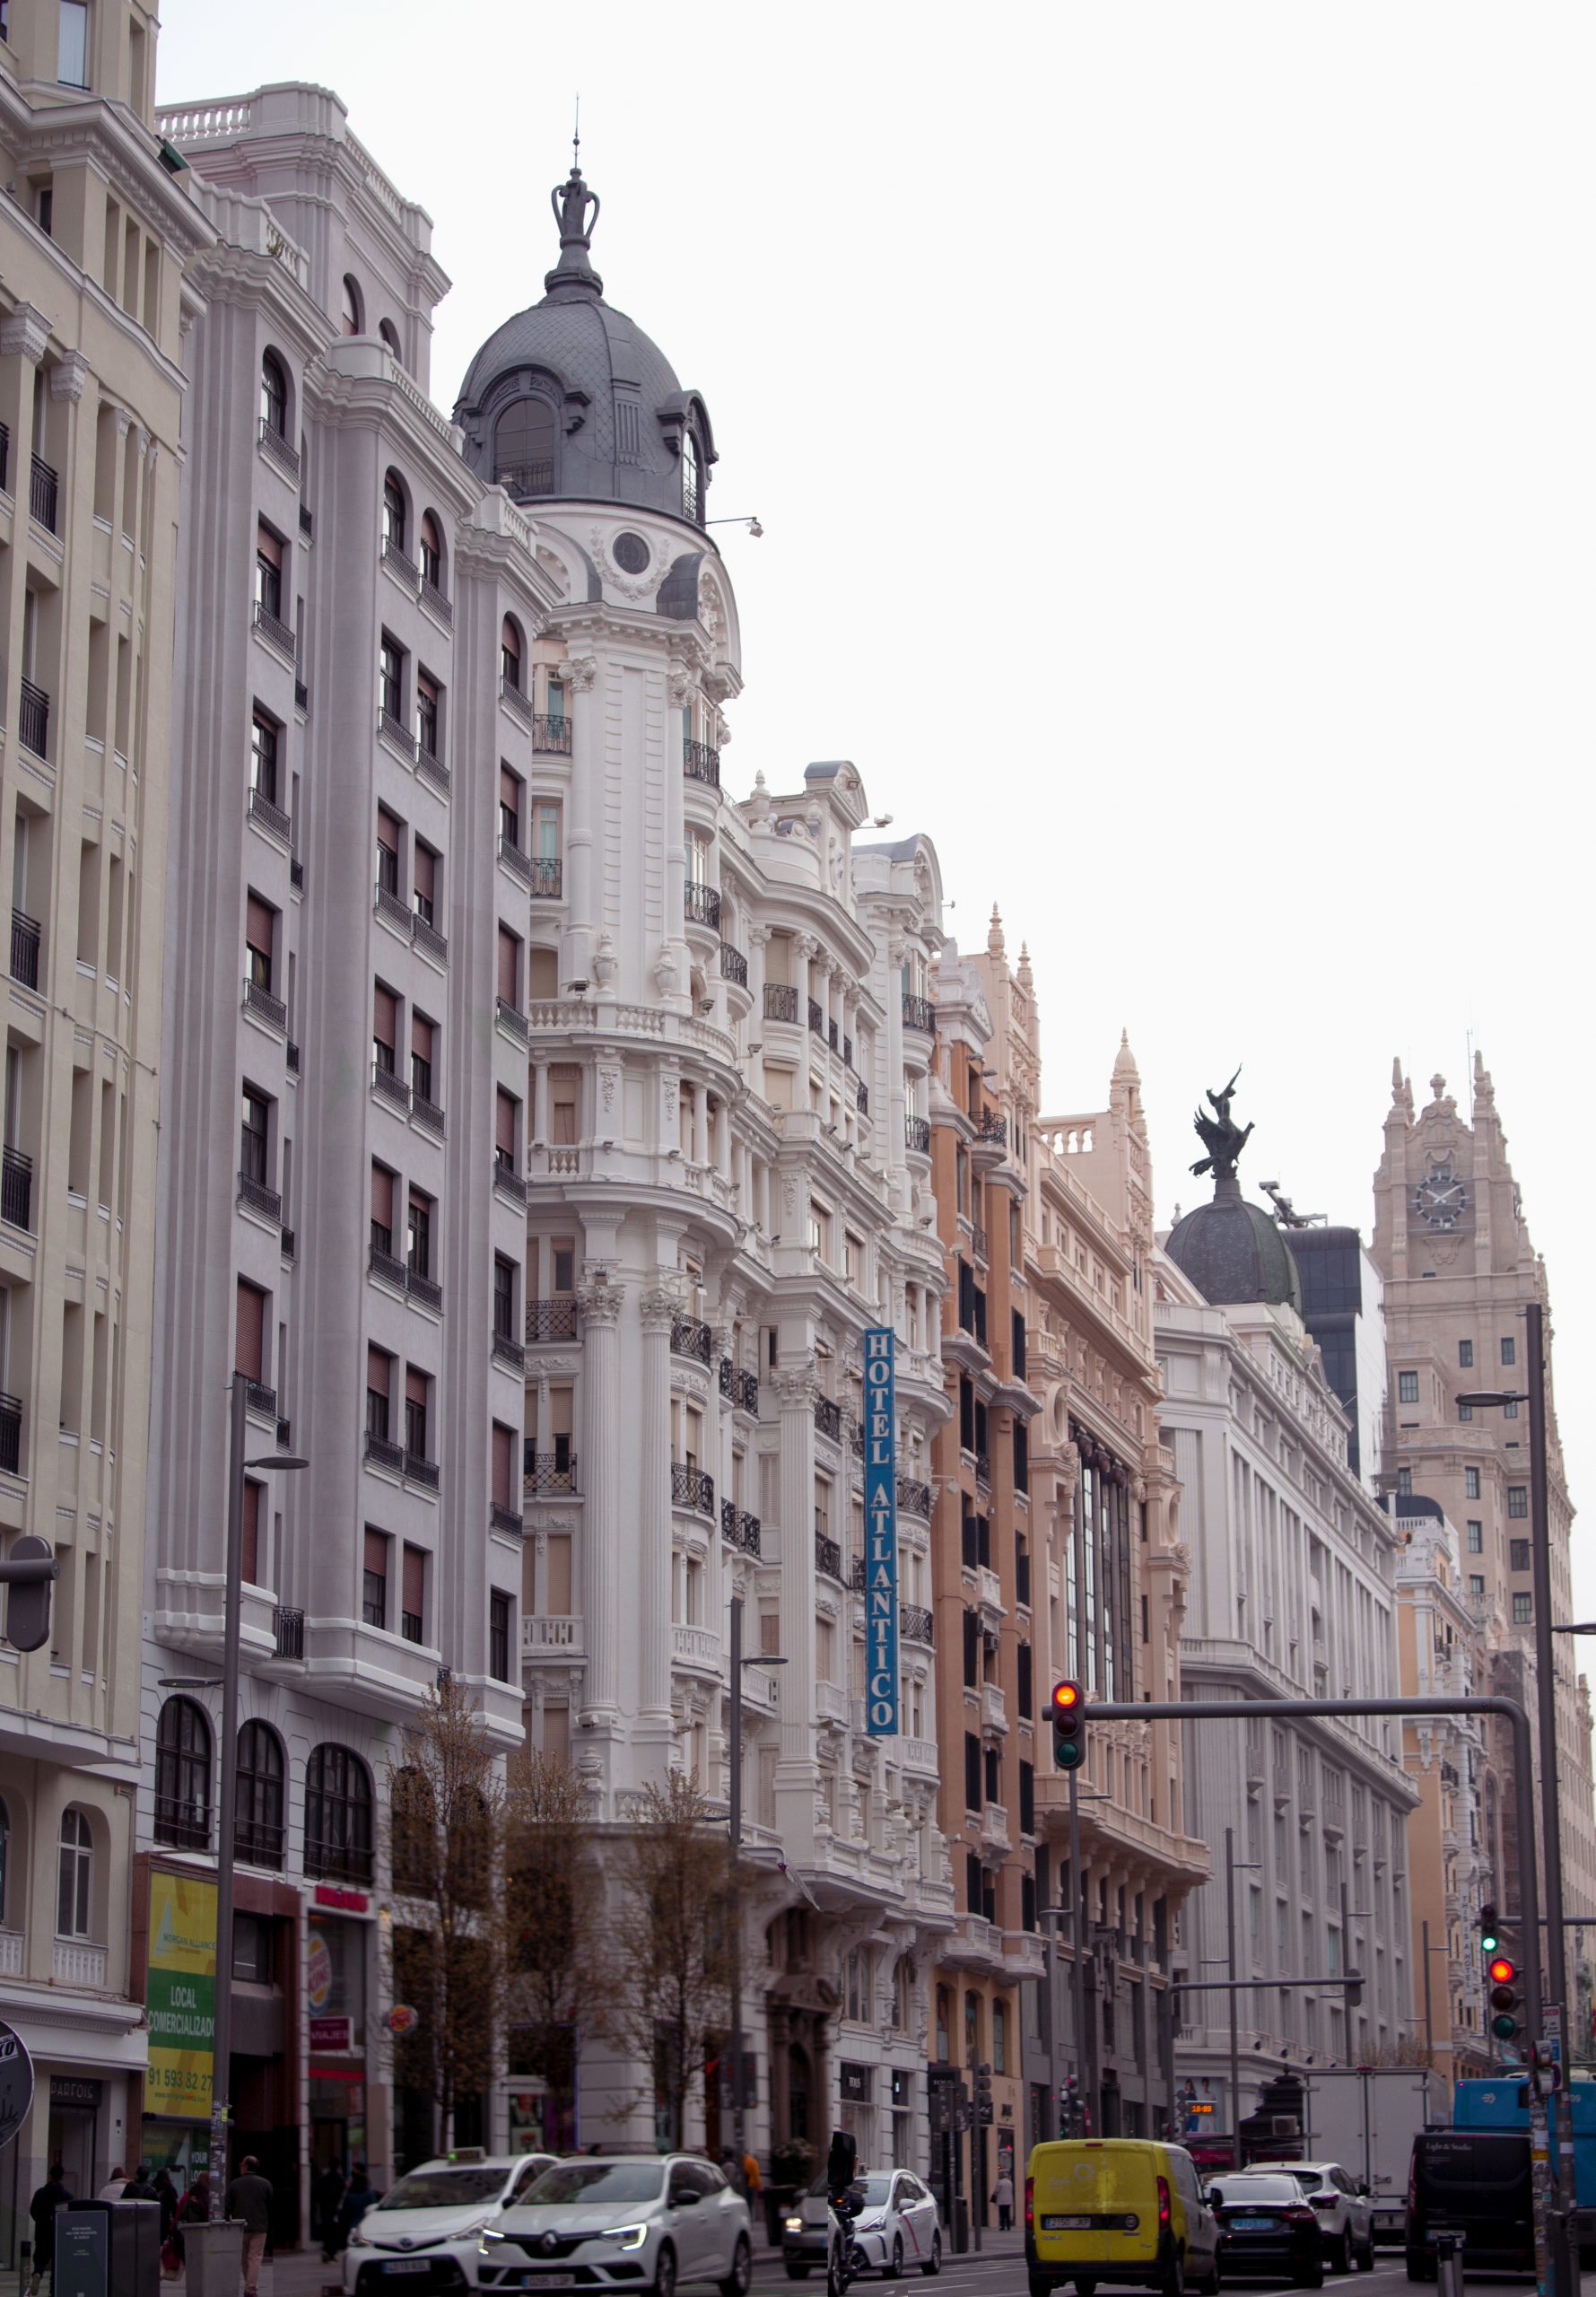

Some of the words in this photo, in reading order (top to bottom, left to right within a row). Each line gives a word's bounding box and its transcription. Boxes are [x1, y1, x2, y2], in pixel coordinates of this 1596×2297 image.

[868, 1333, 890, 1465] HOTEL
[870, 1482, 894, 1727] ATLANTICO
[163, 1932, 188, 1946] MORGAN
[188, 1939, 216, 1951] ALLIANCE
[170, 1985, 197, 2010] LOCAL
[148, 2067, 161, 2086] 91
[164, 2069, 183, 2088] 593
[186, 2072, 199, 2091] 82
[200, 2074, 214, 2092] 27
[848, 2076, 861, 2089] TOUS
[191, 2152, 208, 2164] YOUR
